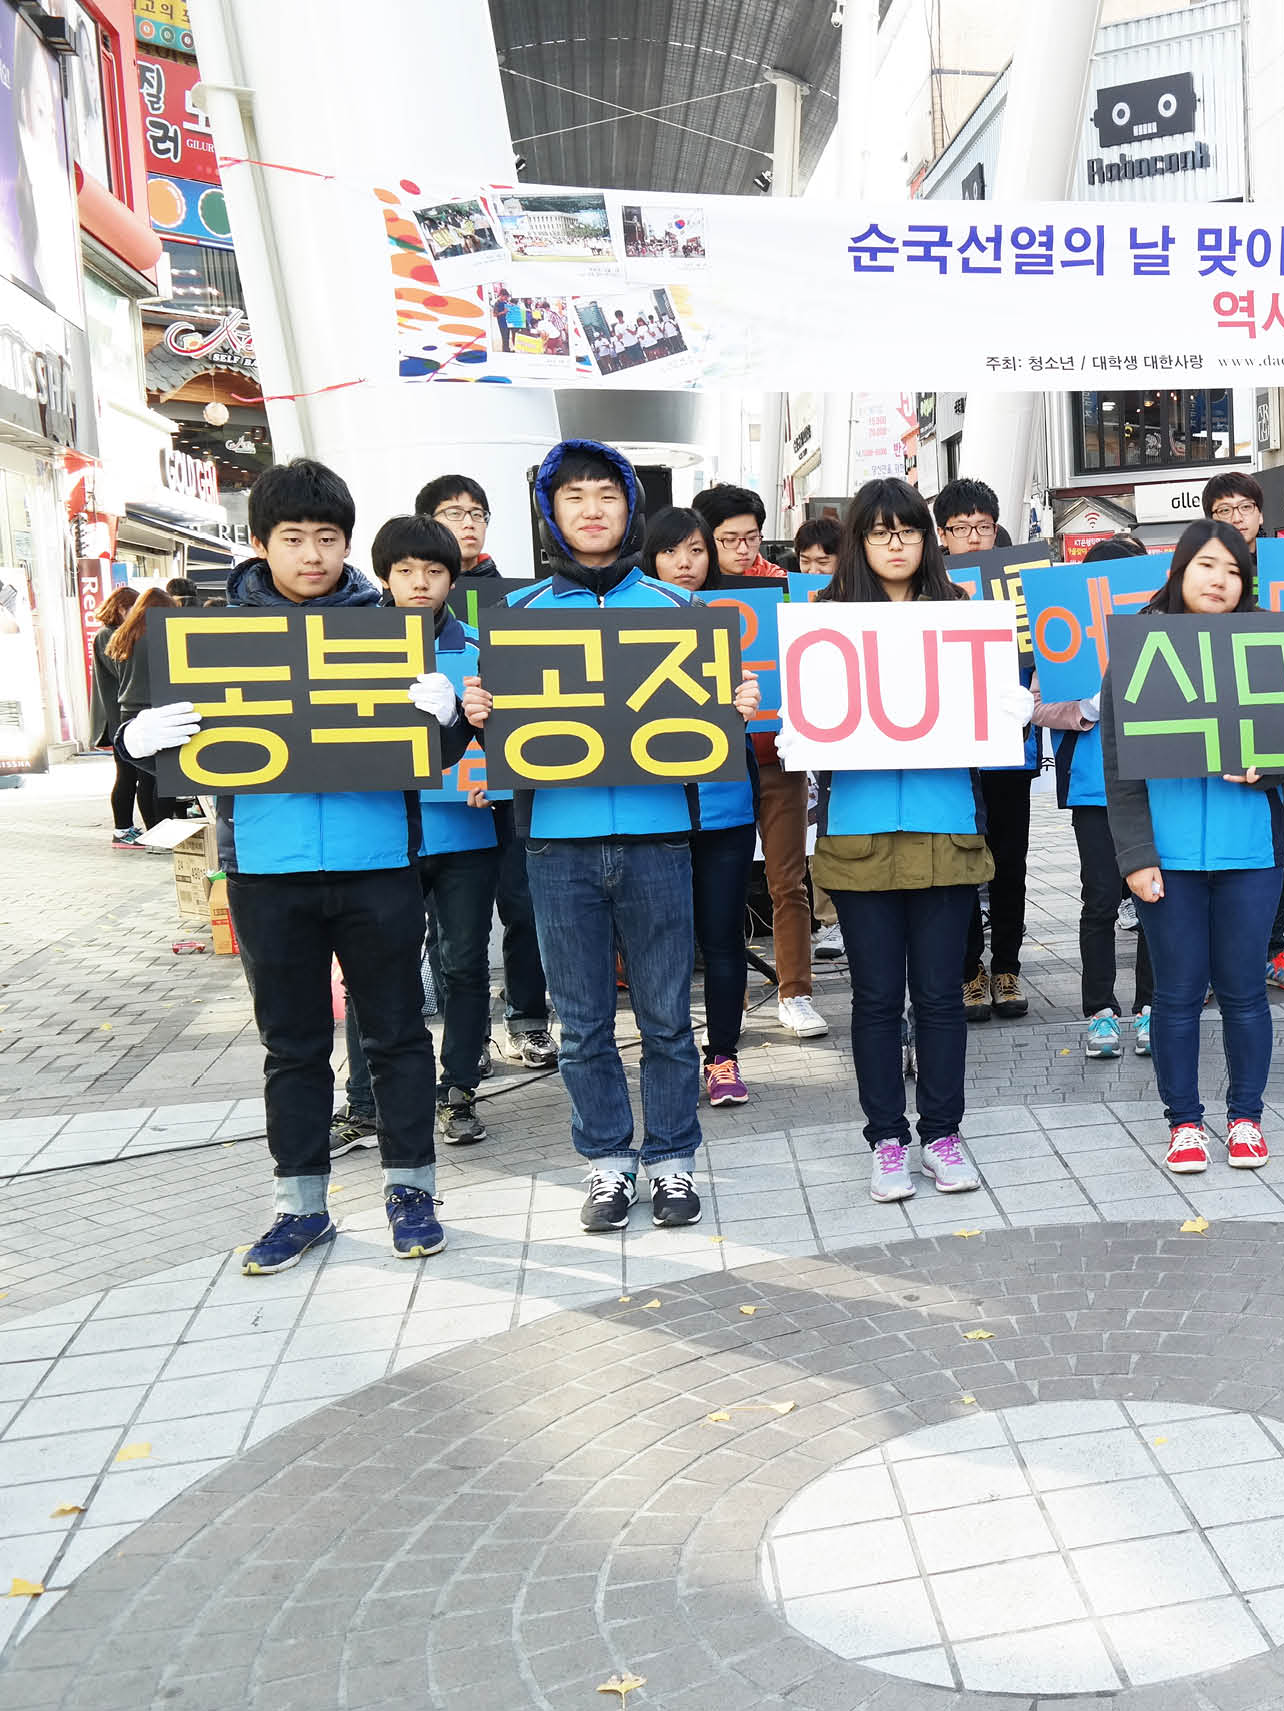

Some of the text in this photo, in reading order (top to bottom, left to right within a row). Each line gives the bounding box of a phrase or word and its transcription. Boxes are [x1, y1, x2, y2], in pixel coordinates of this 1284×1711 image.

[133, 0, 174, 21] 고의
[847, 223, 1105, 276] 순국선열의
[1128, 224, 1176, 276] 날
[986, 355, 1023, 372] 주최:
[1027, 355, 1076, 372] 청소년
[1091, 354, 1140, 372] 대학생
[1143, 354, 1205, 371] 대한사랑
[165, 614, 432, 787] 동북
[490, 628, 732, 782] 공정
[786, 626, 1013, 744] OUT
[0, 760, 32, 769] ISSHA
